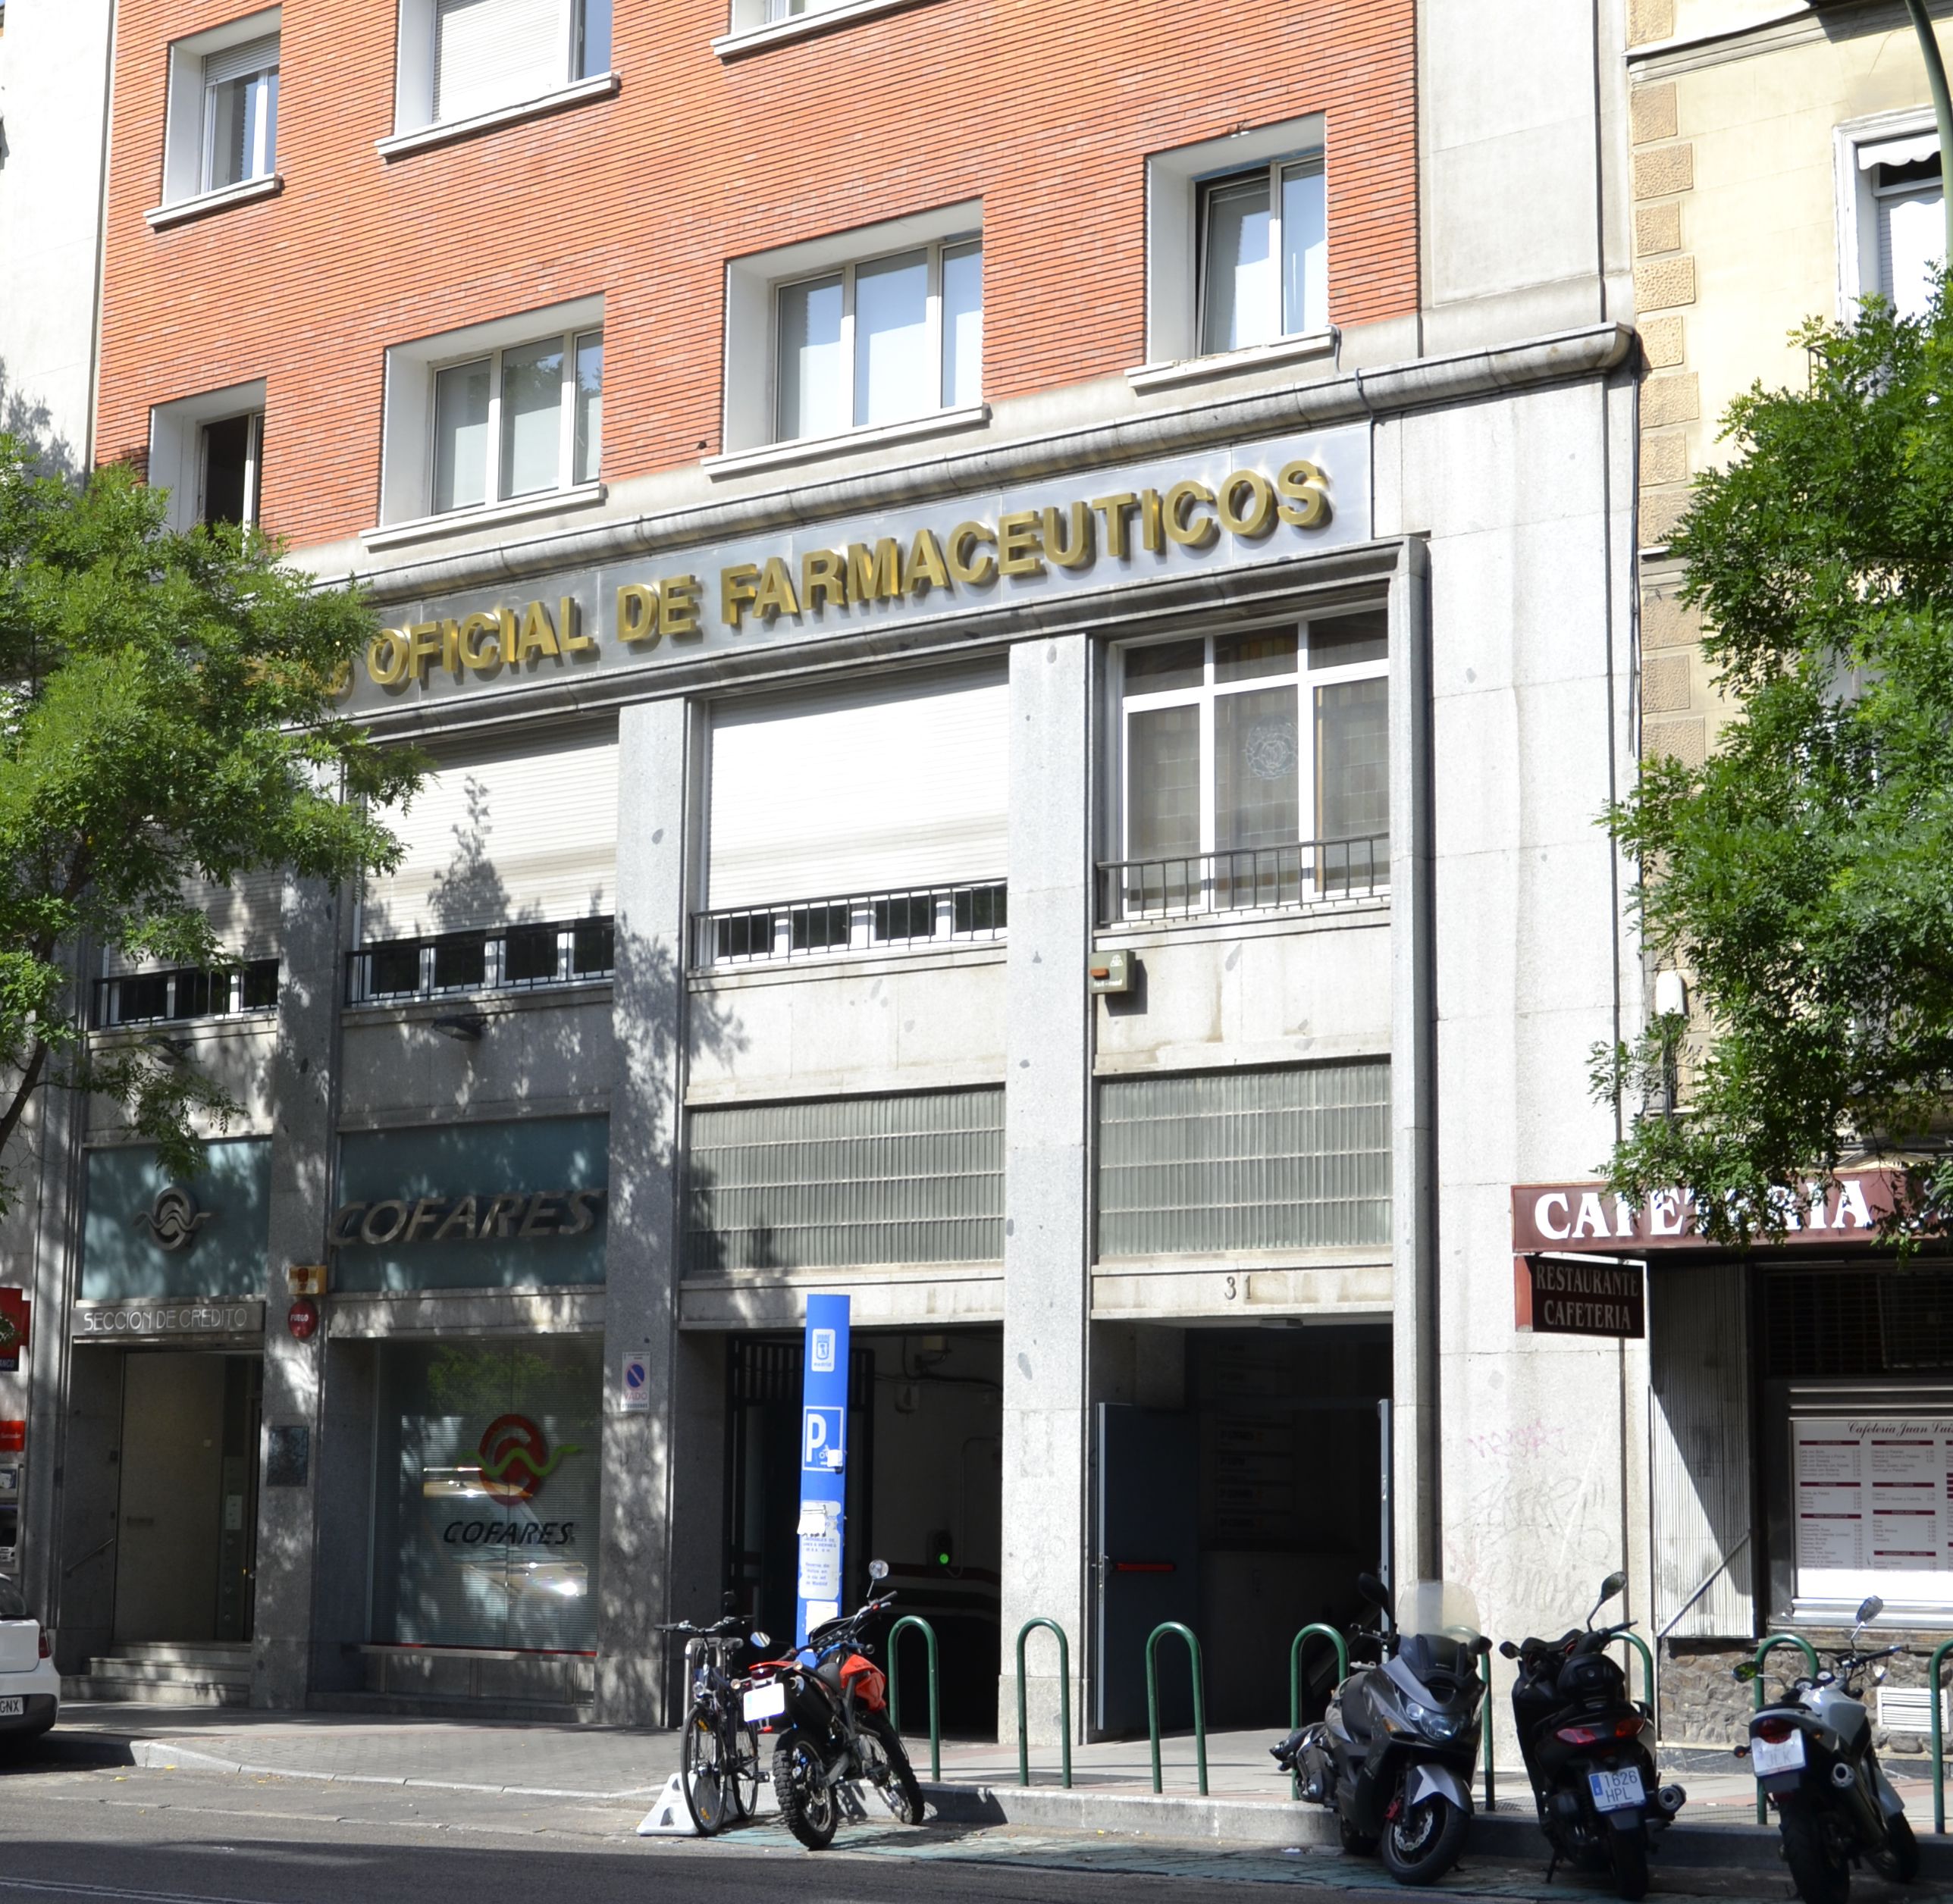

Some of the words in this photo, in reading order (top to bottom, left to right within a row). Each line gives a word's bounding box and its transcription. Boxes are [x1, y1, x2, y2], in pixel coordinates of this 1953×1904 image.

[367, 597, 594, 685] OFICIAL
[617, 574, 697, 642] DE
[721, 459, 1328, 626] FARMACEUTICOS
[328, 1188, 604, 1245] COFARES
[1534, 1179, 1875, 1240] CAFERIA
[1224, 1275, 1252, 1301] 31
[1536, 1265, 1638, 1297] RESTAURANTE
[84, 1311, 152, 1331] SECCION
[156, 1310, 176, 1329] DE
[180, 1308, 247, 1328] CREDITO
[290, 1314, 309, 1322] FUEGO
[1544, 1300, 1632, 1330] CAFETERIA
[806, 1414, 826, 1462] P
[444, 1521, 574, 1545] COFARES
[1604, 1770, 1638, 1788] 1626
[1606, 1787, 1632, 1803] HPL
